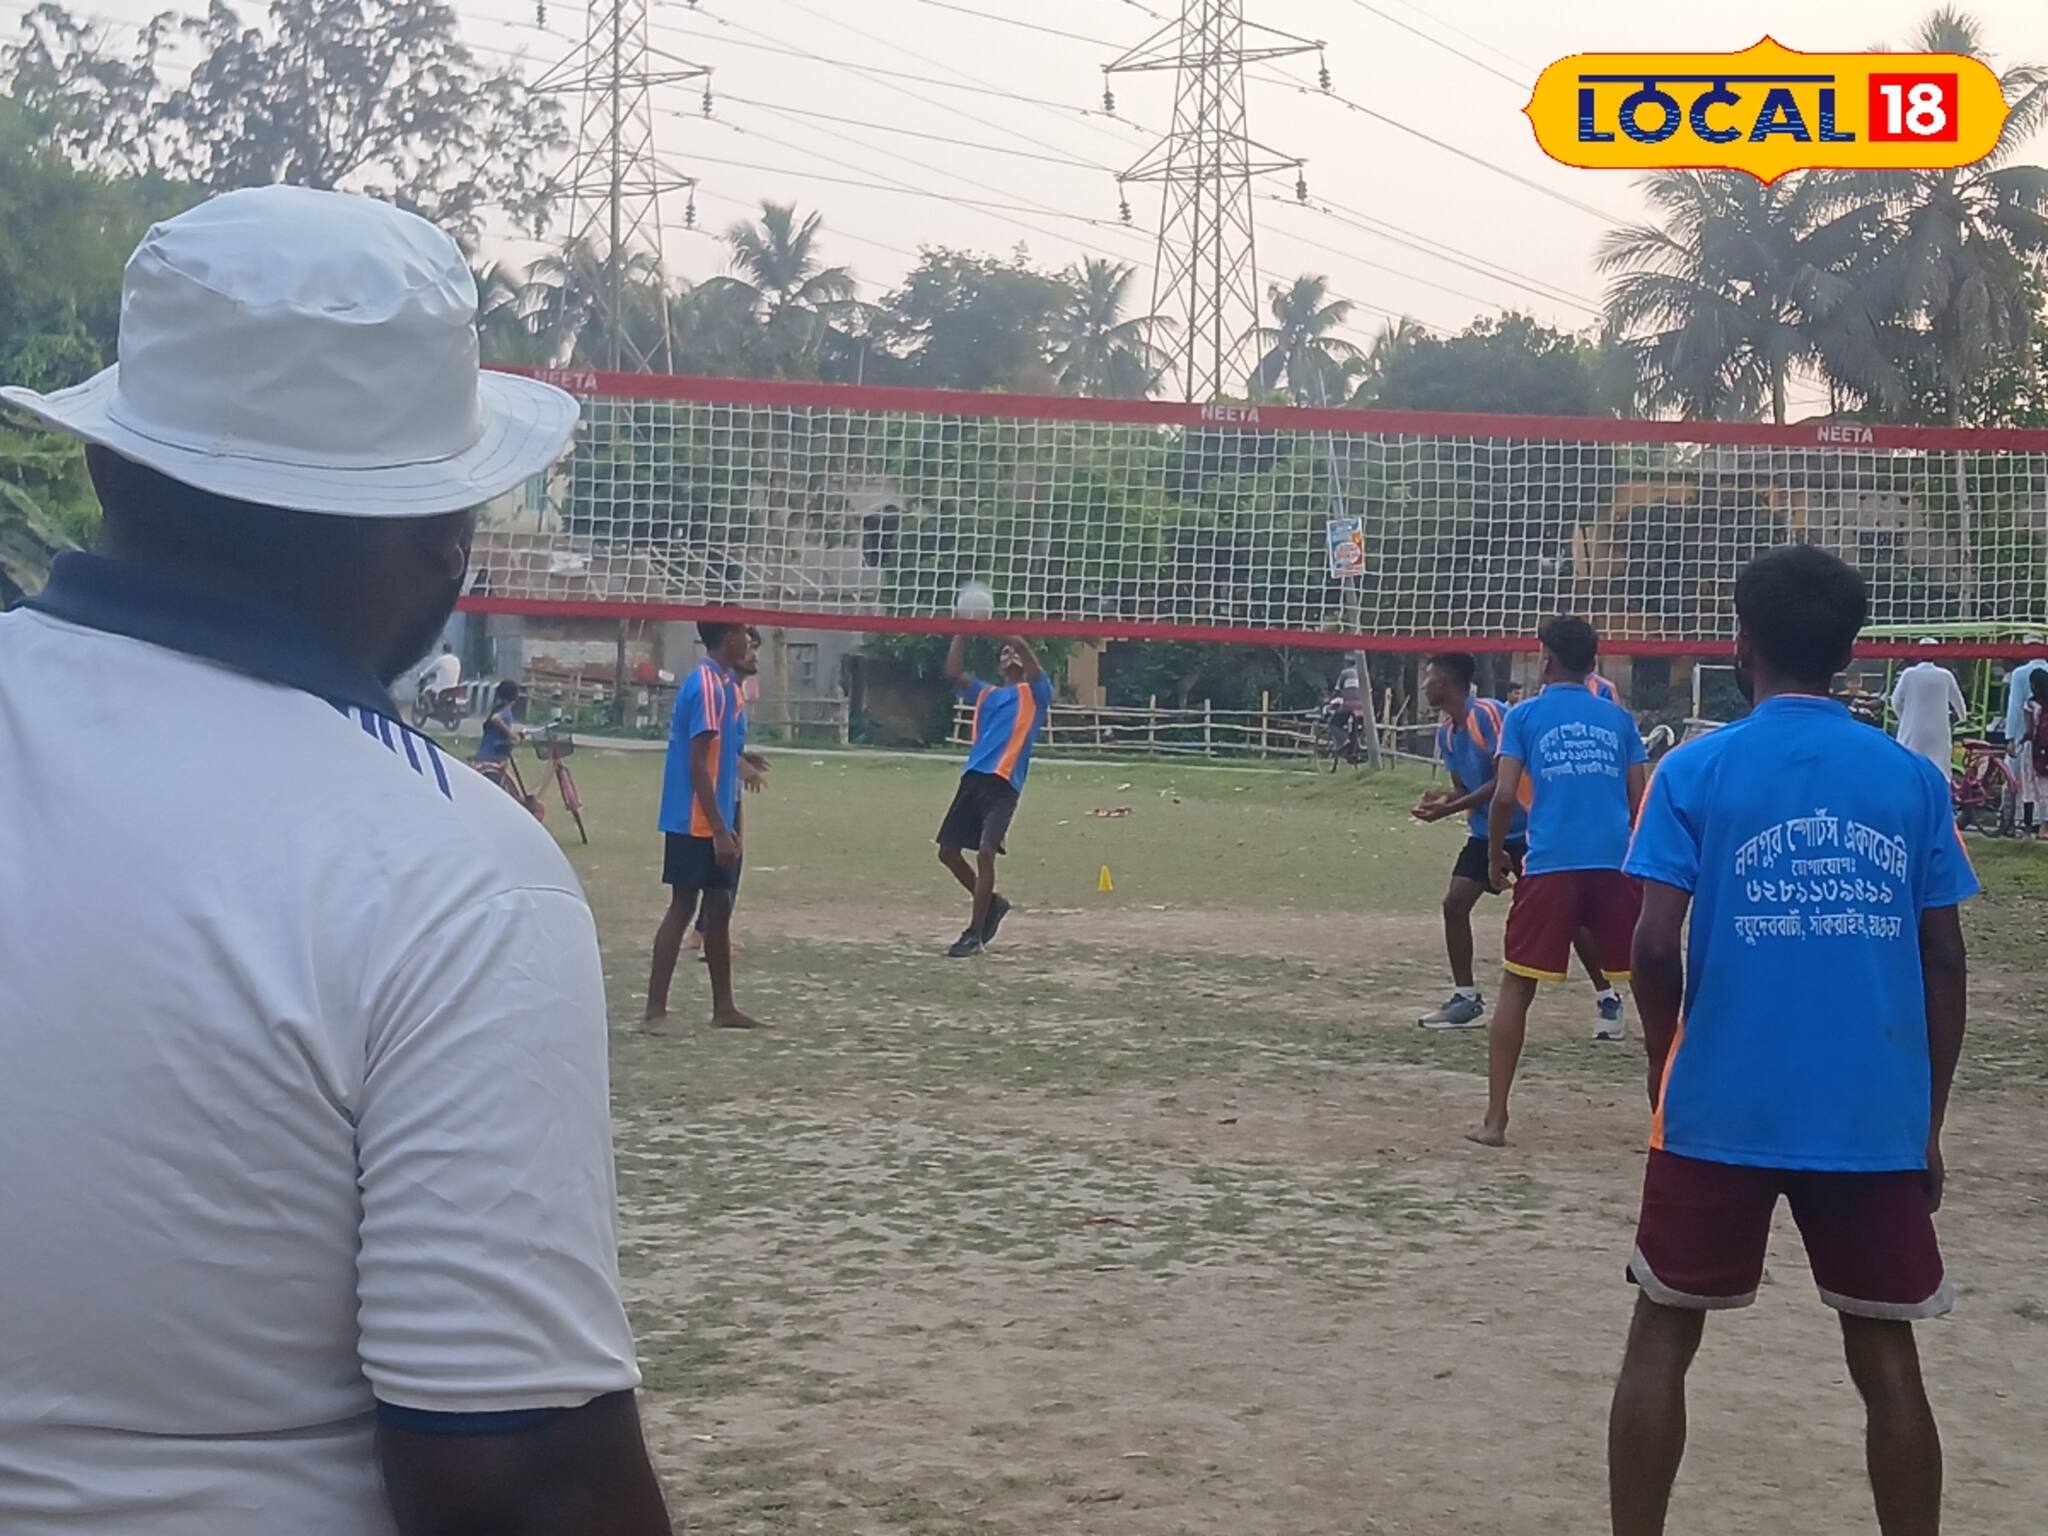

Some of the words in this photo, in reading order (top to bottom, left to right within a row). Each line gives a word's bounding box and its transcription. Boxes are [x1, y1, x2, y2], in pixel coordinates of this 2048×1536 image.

[1200, 404, 1260, 423] NEETA
[1817, 425, 1874, 443] NEETA
[1735, 824, 1782, 876] নলপুর
[1844, 820, 1908, 883] একাডেমি
